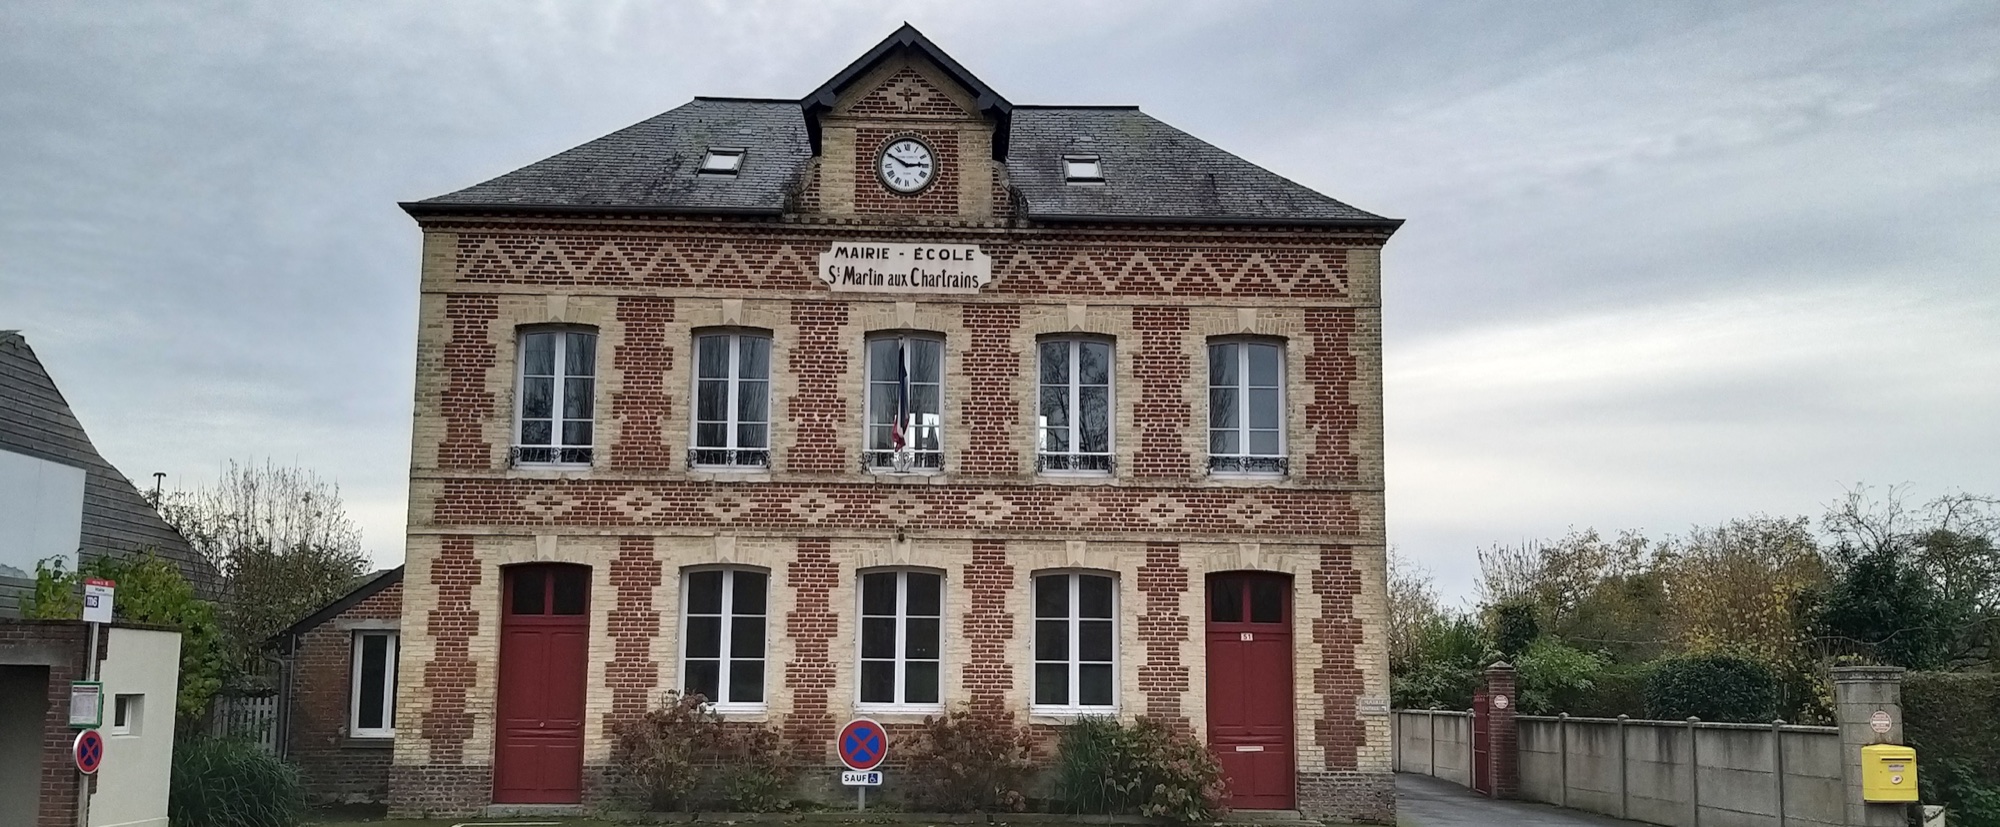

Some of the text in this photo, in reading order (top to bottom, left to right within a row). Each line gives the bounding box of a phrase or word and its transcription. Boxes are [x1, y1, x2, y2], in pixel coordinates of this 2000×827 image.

[834, 246, 890, 260] MAIRIE
[914, 247, 975, 261] ÉCOLE
[842, 266, 884, 286] Martin
[887, 272, 908, 287] aux
[910, 267, 979, 288] Chartrains
[844, 774, 867, 782] SAUF
